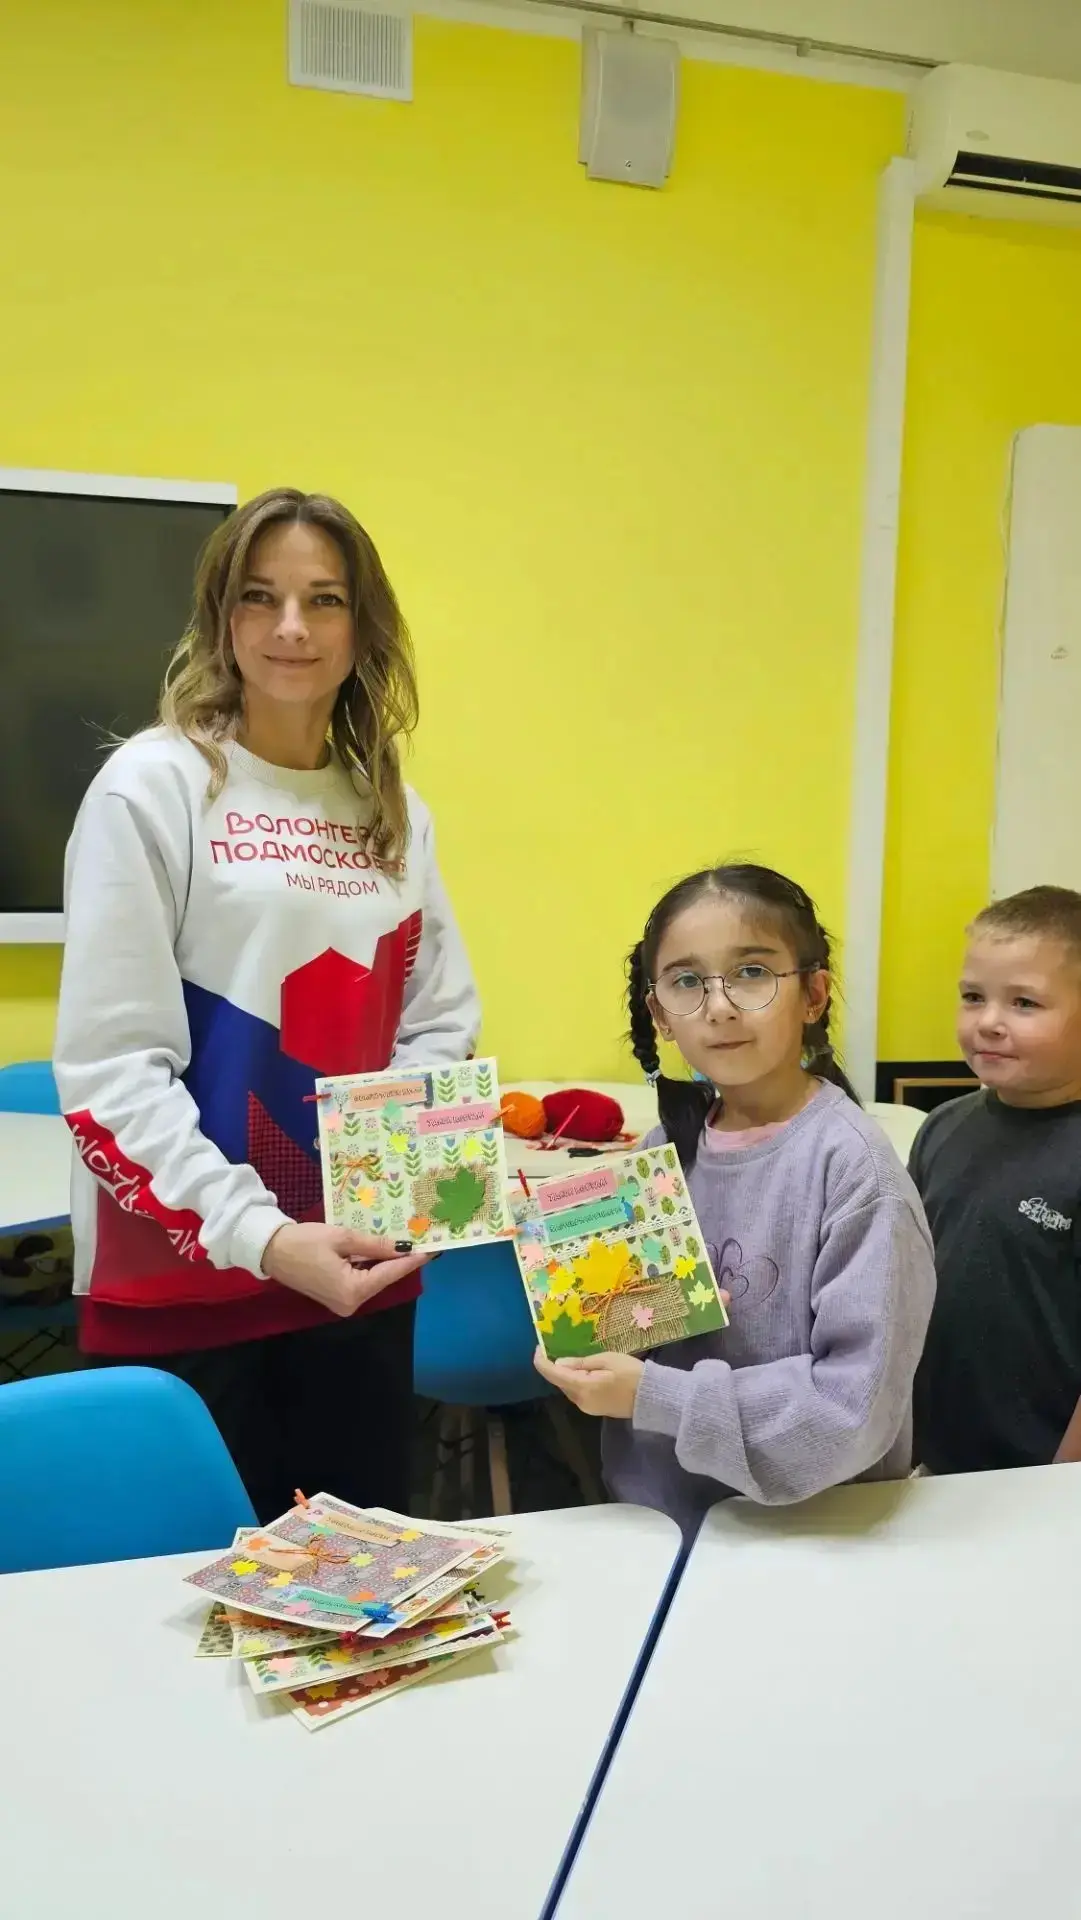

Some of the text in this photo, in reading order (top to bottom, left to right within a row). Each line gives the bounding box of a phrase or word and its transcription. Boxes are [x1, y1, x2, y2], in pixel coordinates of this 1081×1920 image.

[225, 811, 386, 847] ВОЛОНТЕР
[286, 871, 380, 898] МЫ РЯДОМ
[72, 1123, 154, 1219] ЯДОМ
